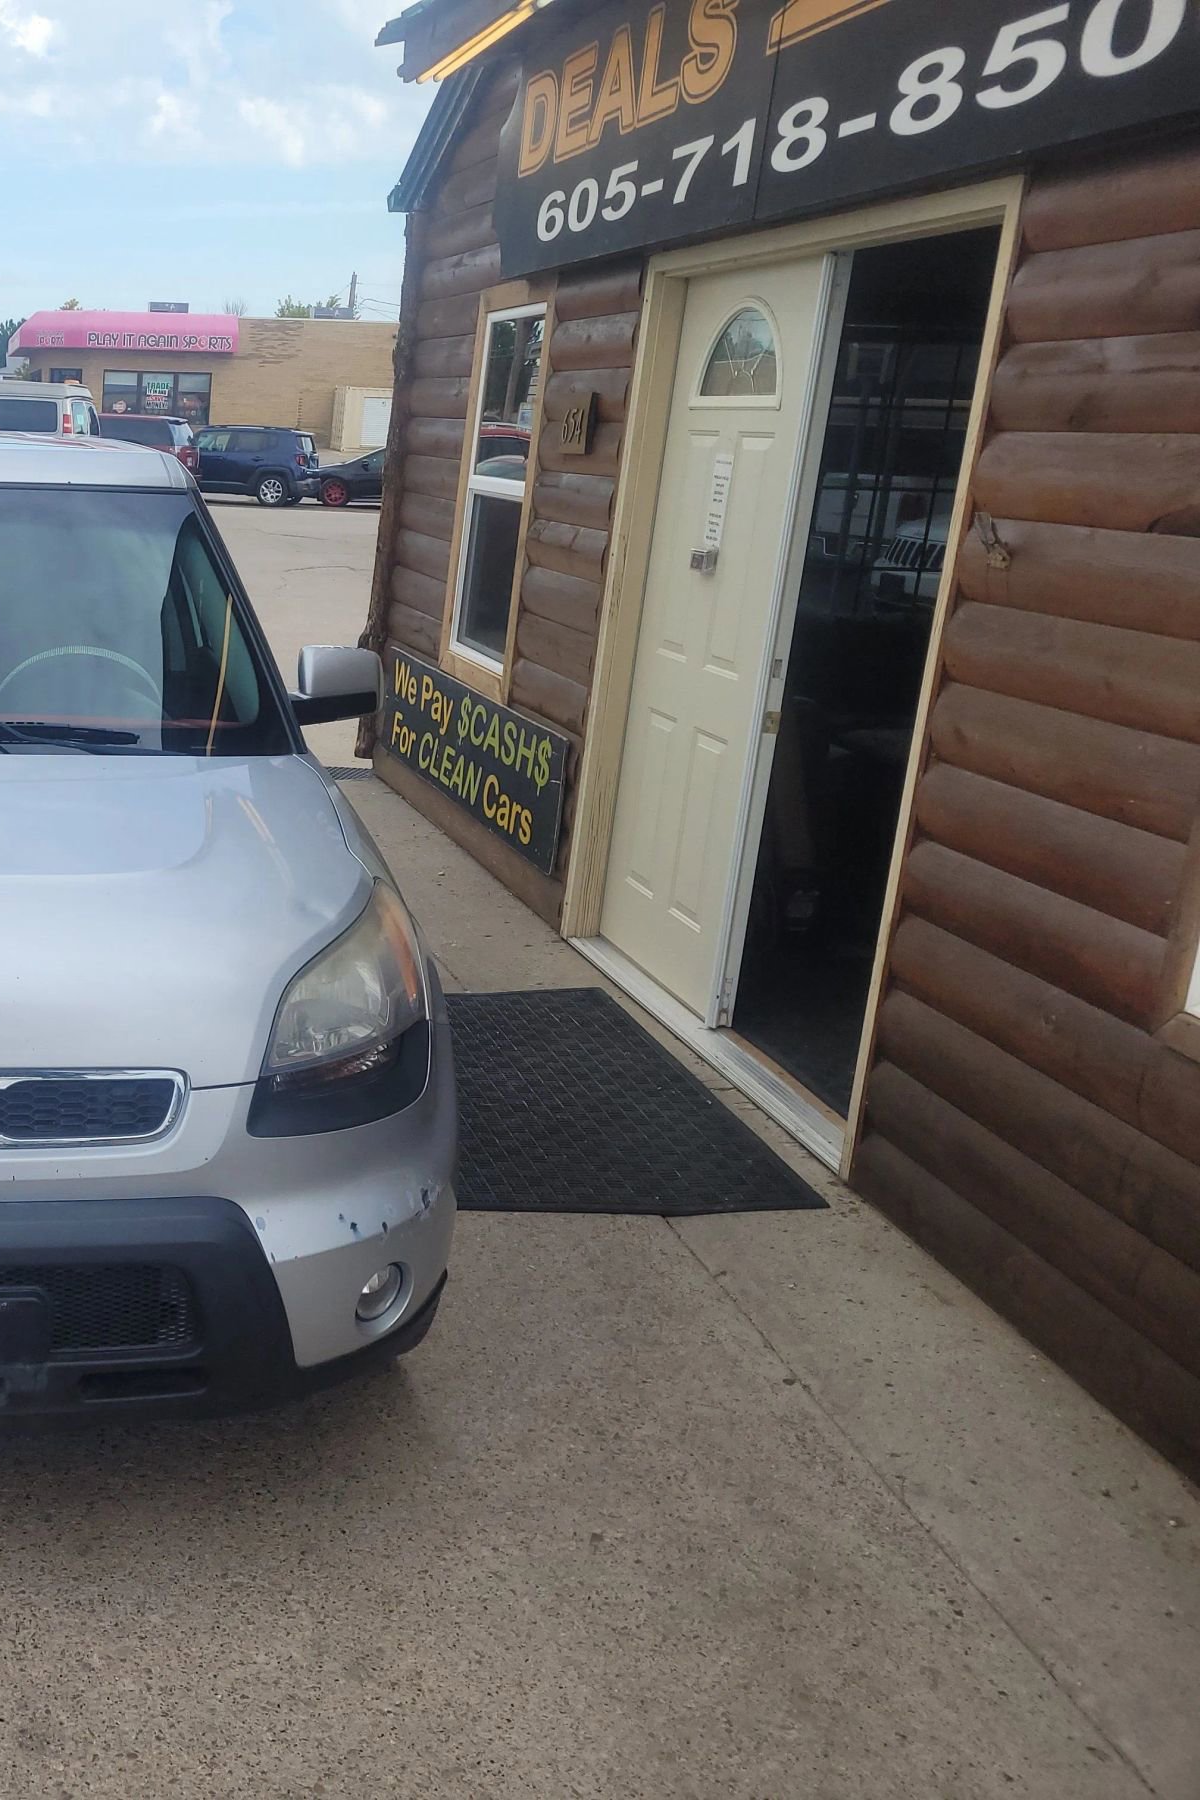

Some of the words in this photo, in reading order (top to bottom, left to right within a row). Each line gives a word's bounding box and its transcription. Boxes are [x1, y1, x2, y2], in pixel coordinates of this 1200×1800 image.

[518, 0, 738, 178] DEALS
[87, 332, 119, 346] PLAY
[122, 333, 135, 347] IT
[137, 333, 179, 348] AGAIN
[182, 335, 233, 350] SPORTS
[562, 408, 585, 444] 654
[391, 711, 417, 758] For
[418, 732, 483, 806] CLEAN
[482, 774, 533, 845] Cars
[394, 658, 417, 705] We
[420, 675, 453, 736] Pay
[457, 693, 552, 796] $CASH$
